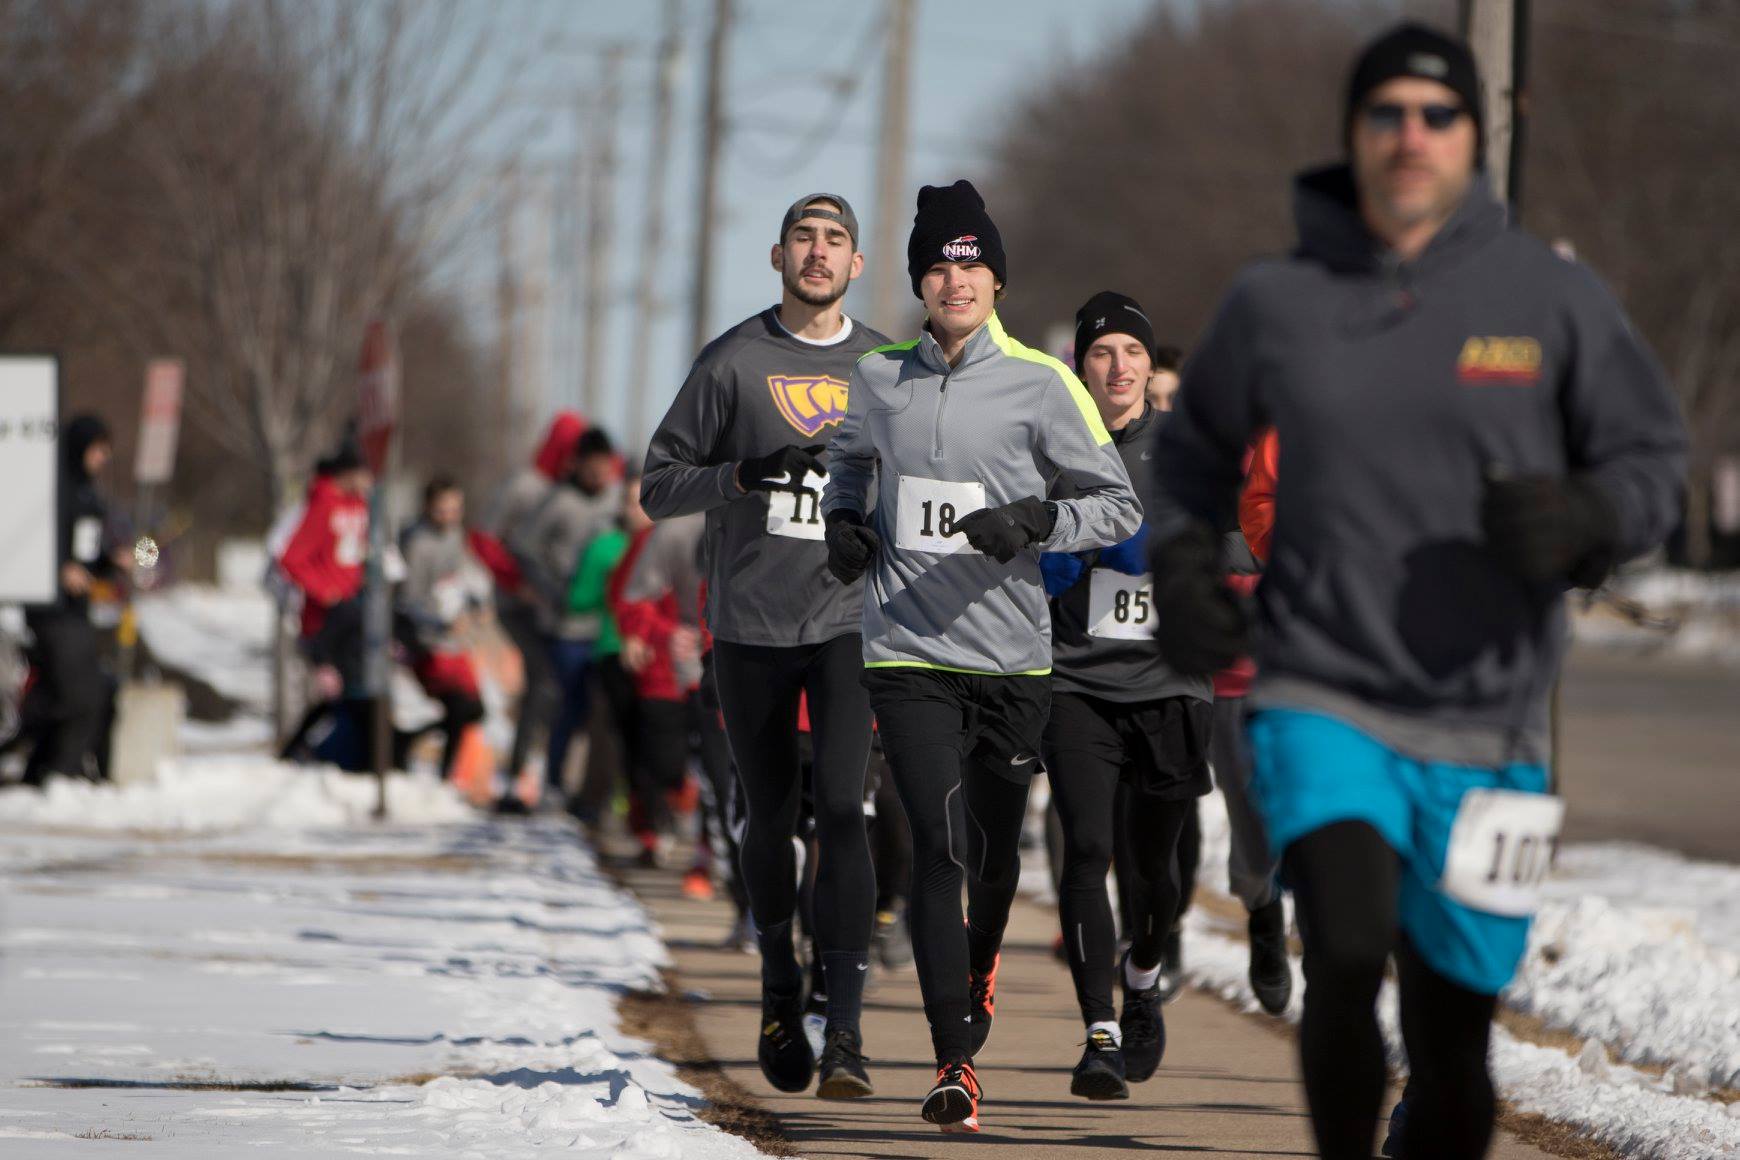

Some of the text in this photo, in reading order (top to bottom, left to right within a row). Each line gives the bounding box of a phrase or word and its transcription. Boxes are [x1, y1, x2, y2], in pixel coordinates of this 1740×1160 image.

[945, 244, 978, 257] NHM
[920, 500, 956, 538] 18
[1114, 589, 1150, 625] 85
